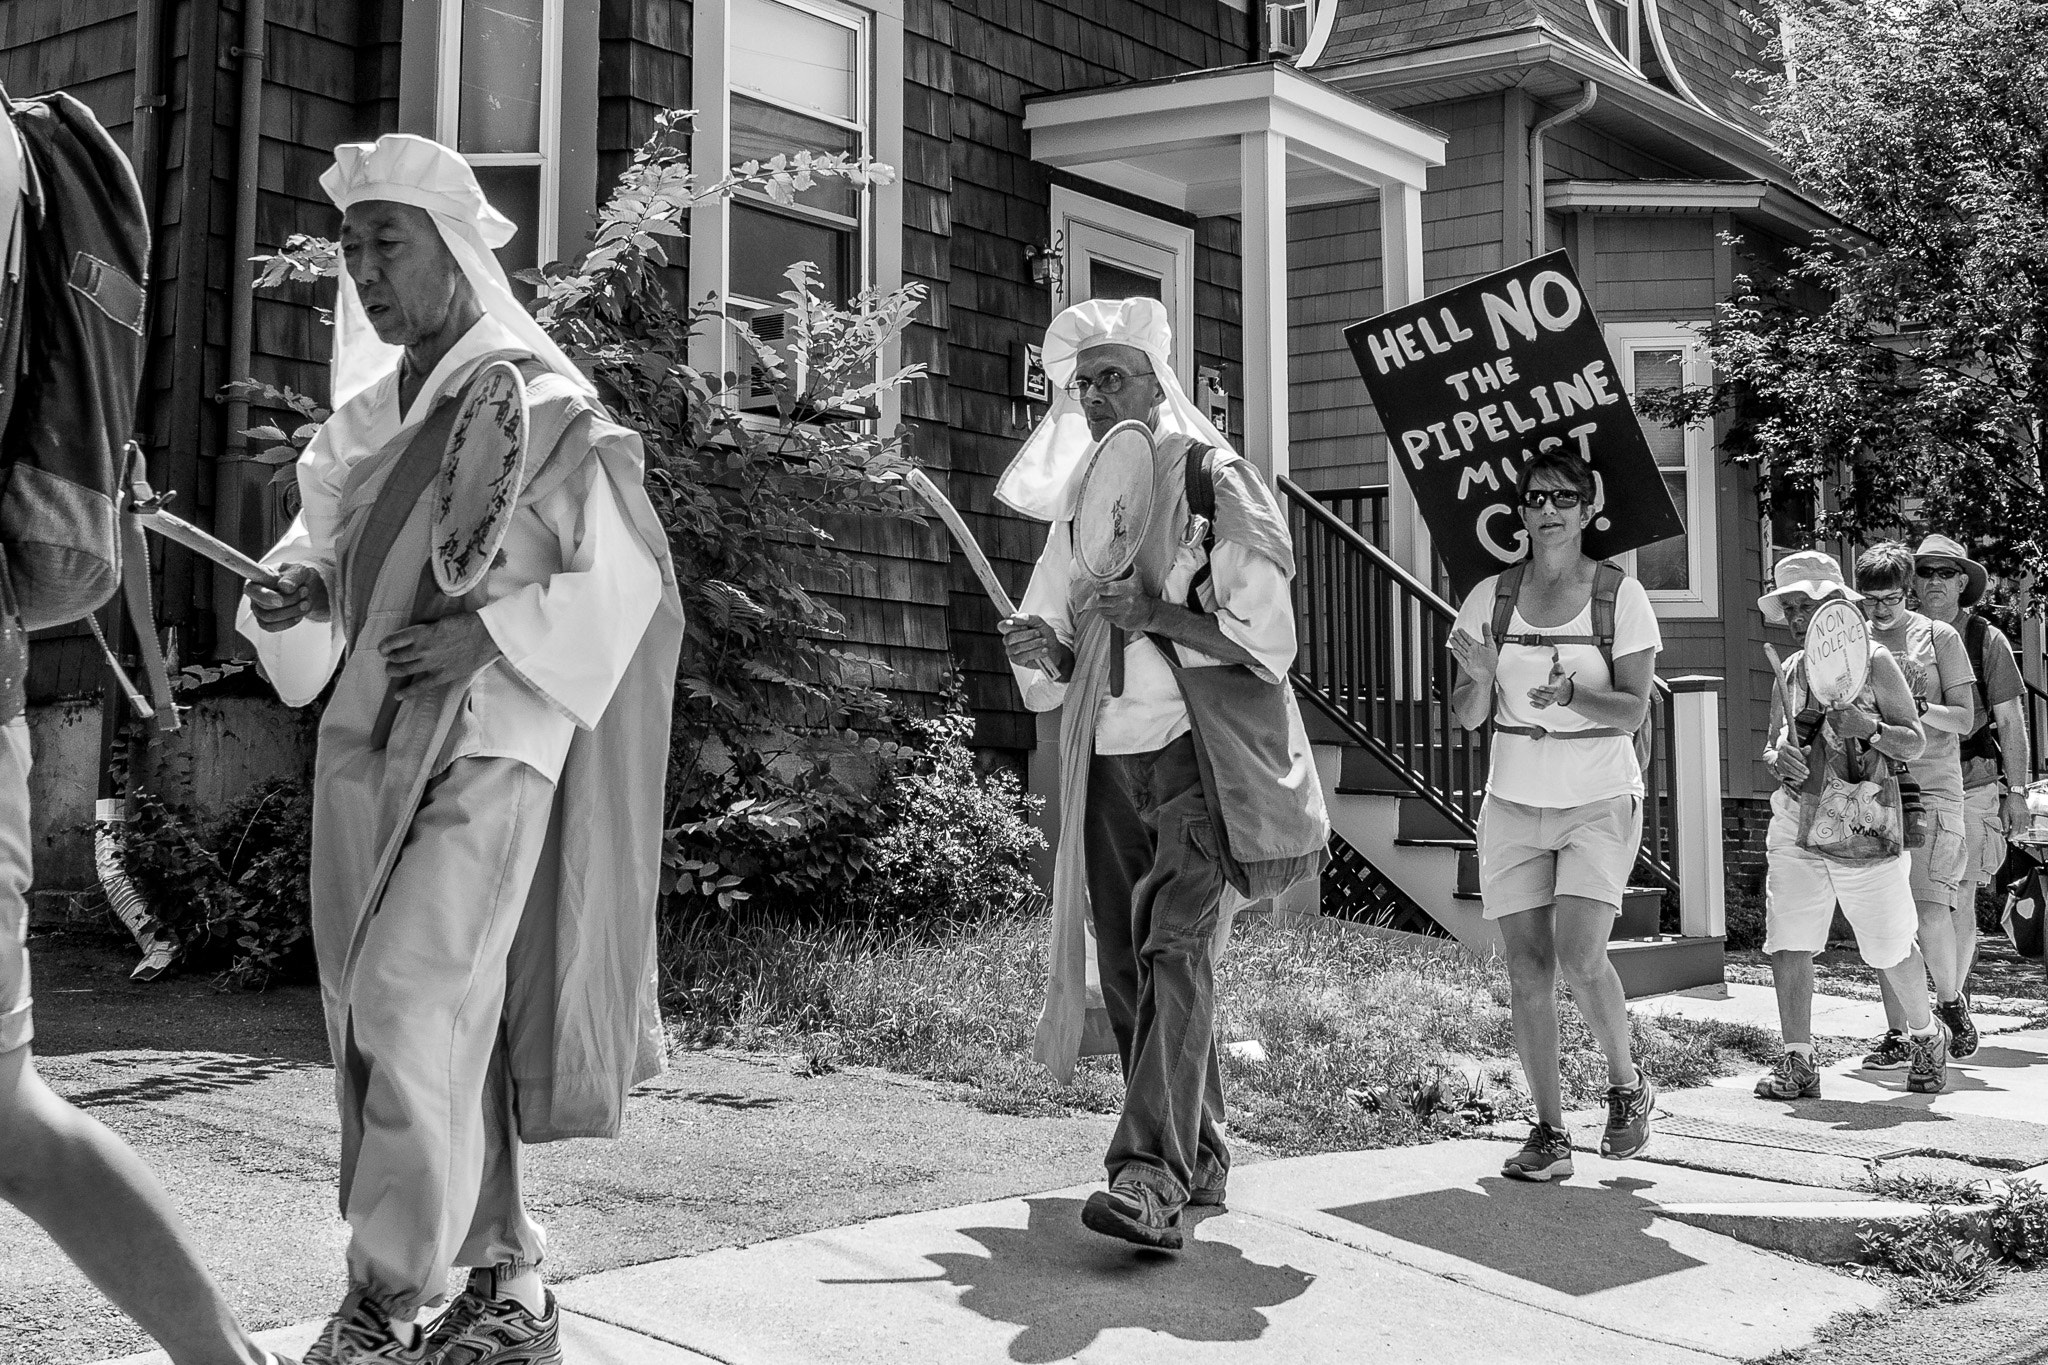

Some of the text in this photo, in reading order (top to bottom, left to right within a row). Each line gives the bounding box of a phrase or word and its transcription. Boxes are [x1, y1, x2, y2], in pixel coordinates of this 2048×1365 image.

[1368, 270, 1582, 375] HELL NO
[1445, 356, 1520, 401] THE
[1402, 359, 1618, 470] PIPELINE
[1457, 422, 1597, 500] MT
[1476, 470, 1611, 564] G!
[1808, 622, 1863, 666] VIOLENCE
[1816, 608, 1845, 640] NON
[1849, 823, 1879, 838] WIND
